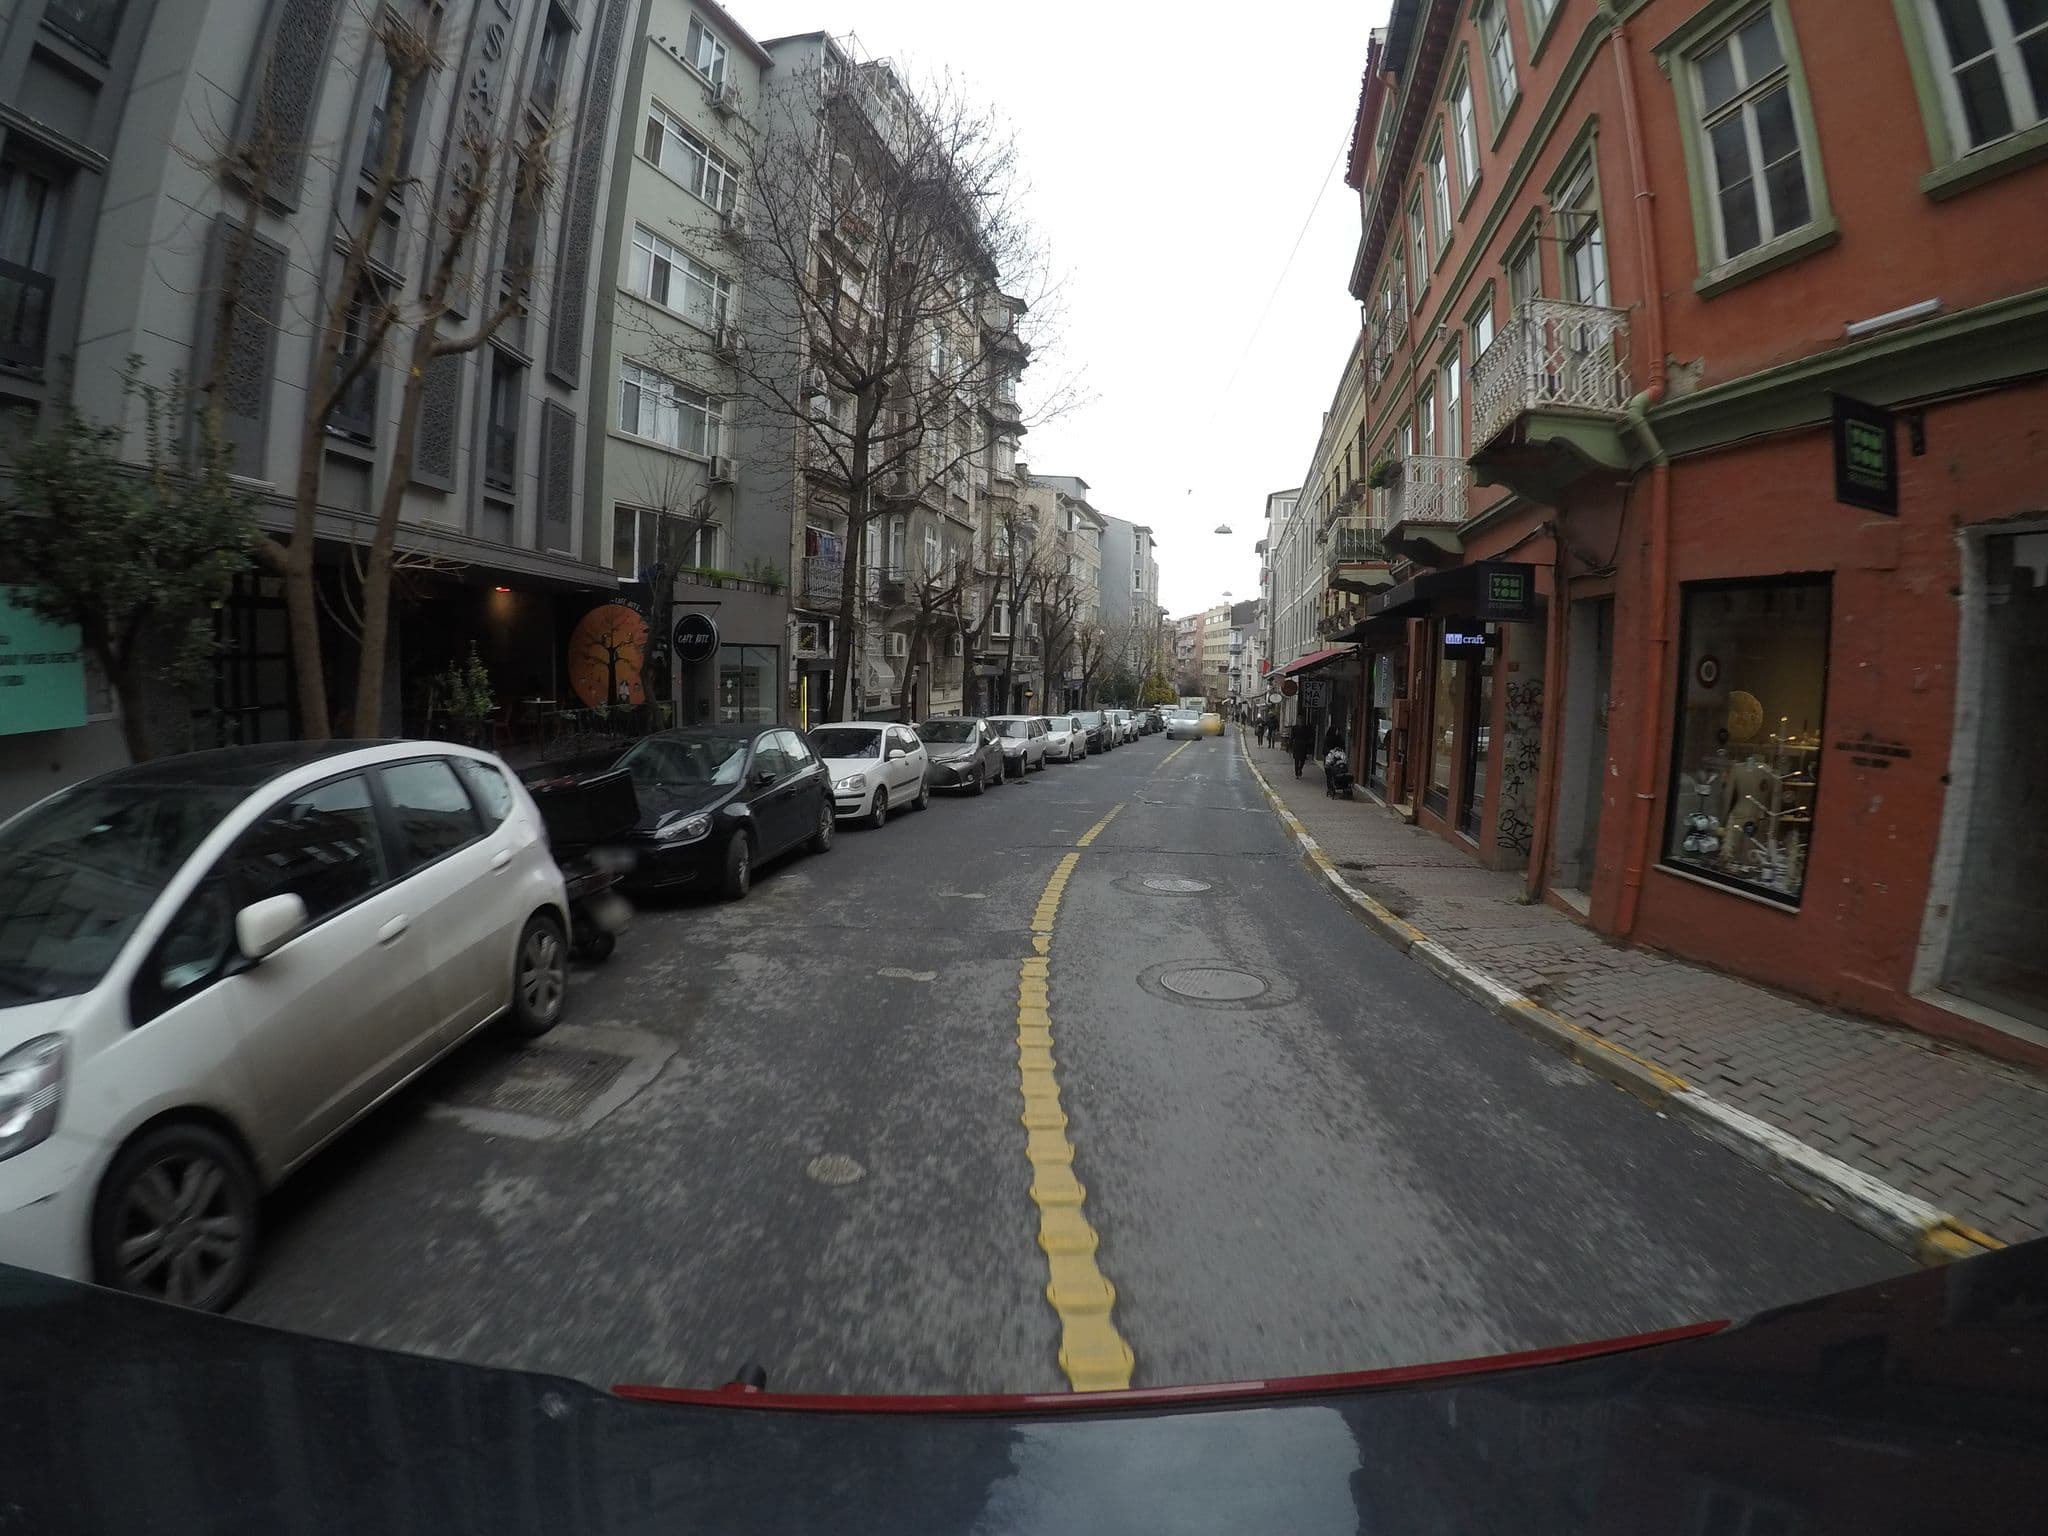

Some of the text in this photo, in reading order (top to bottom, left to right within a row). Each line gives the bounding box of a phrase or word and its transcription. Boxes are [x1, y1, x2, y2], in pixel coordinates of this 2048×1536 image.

[1463, 634, 1486, 644] craft
[1305, 683, 1324, 691] PEY
[1305, 698, 1319, 706] NE
